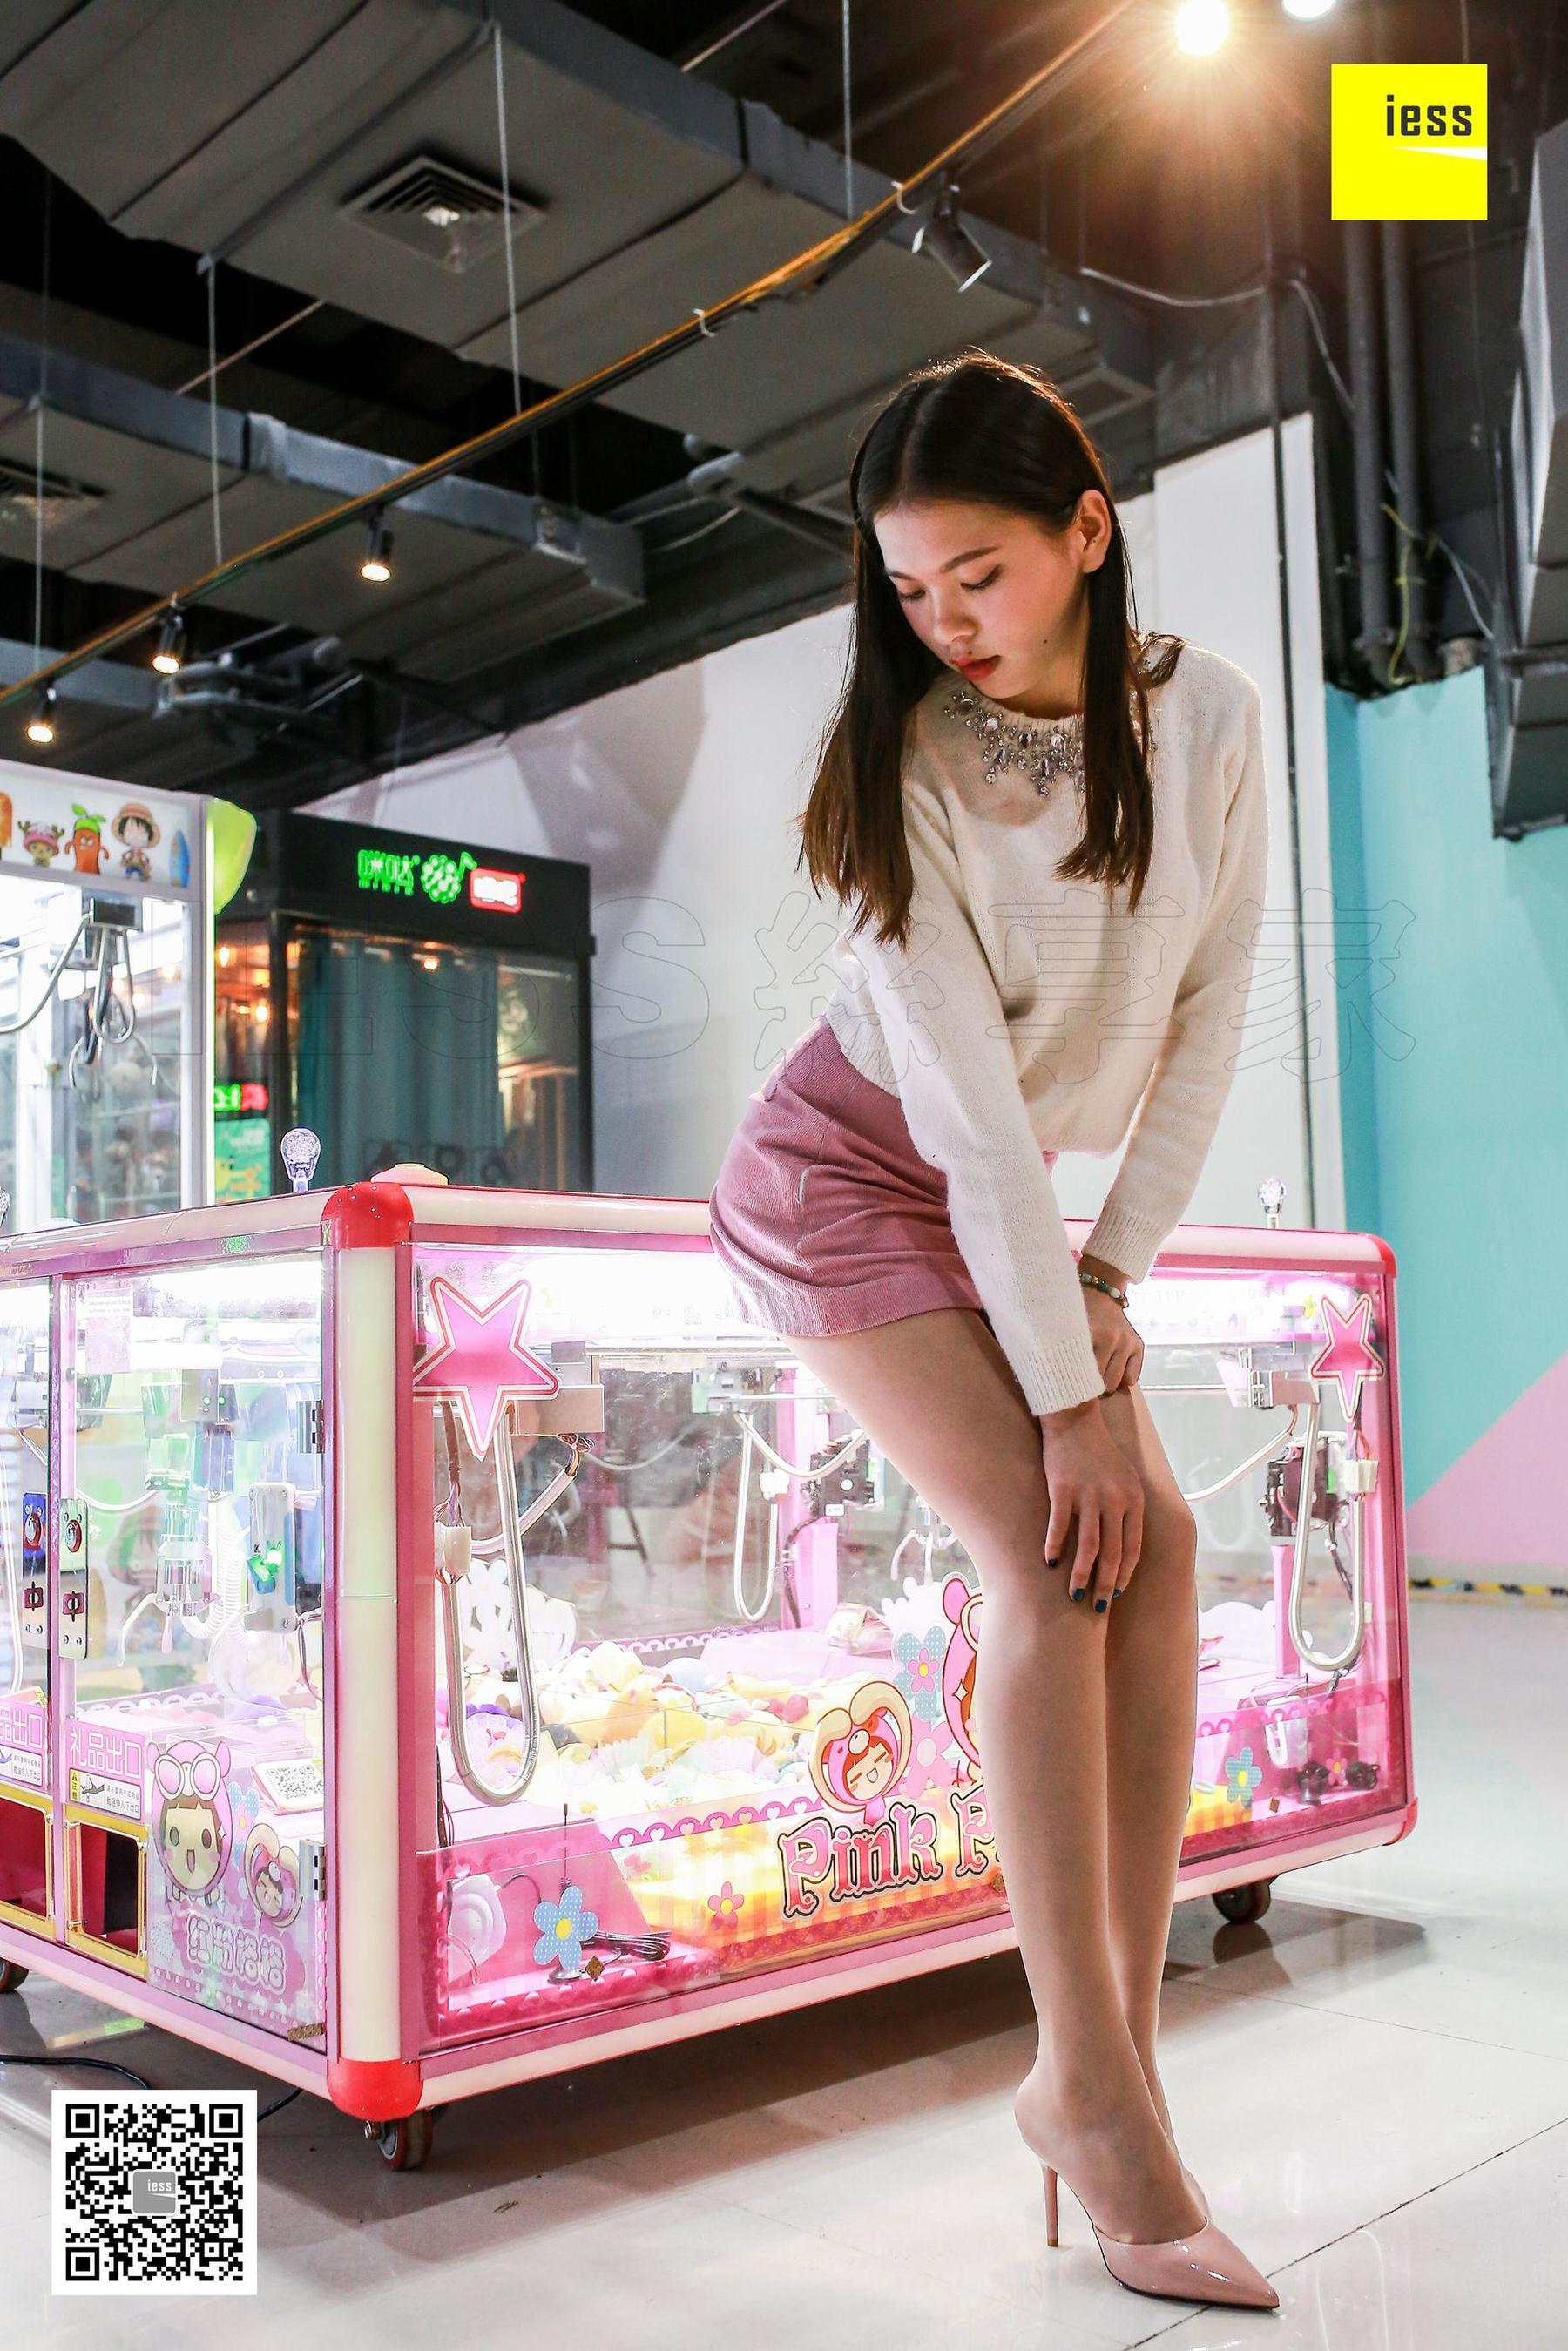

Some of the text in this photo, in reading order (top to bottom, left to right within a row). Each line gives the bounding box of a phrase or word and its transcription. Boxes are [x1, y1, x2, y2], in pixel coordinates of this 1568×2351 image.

[70, 1726, 142, 1780] 礼品出口
[778, 1801, 943, 1918] Pink
